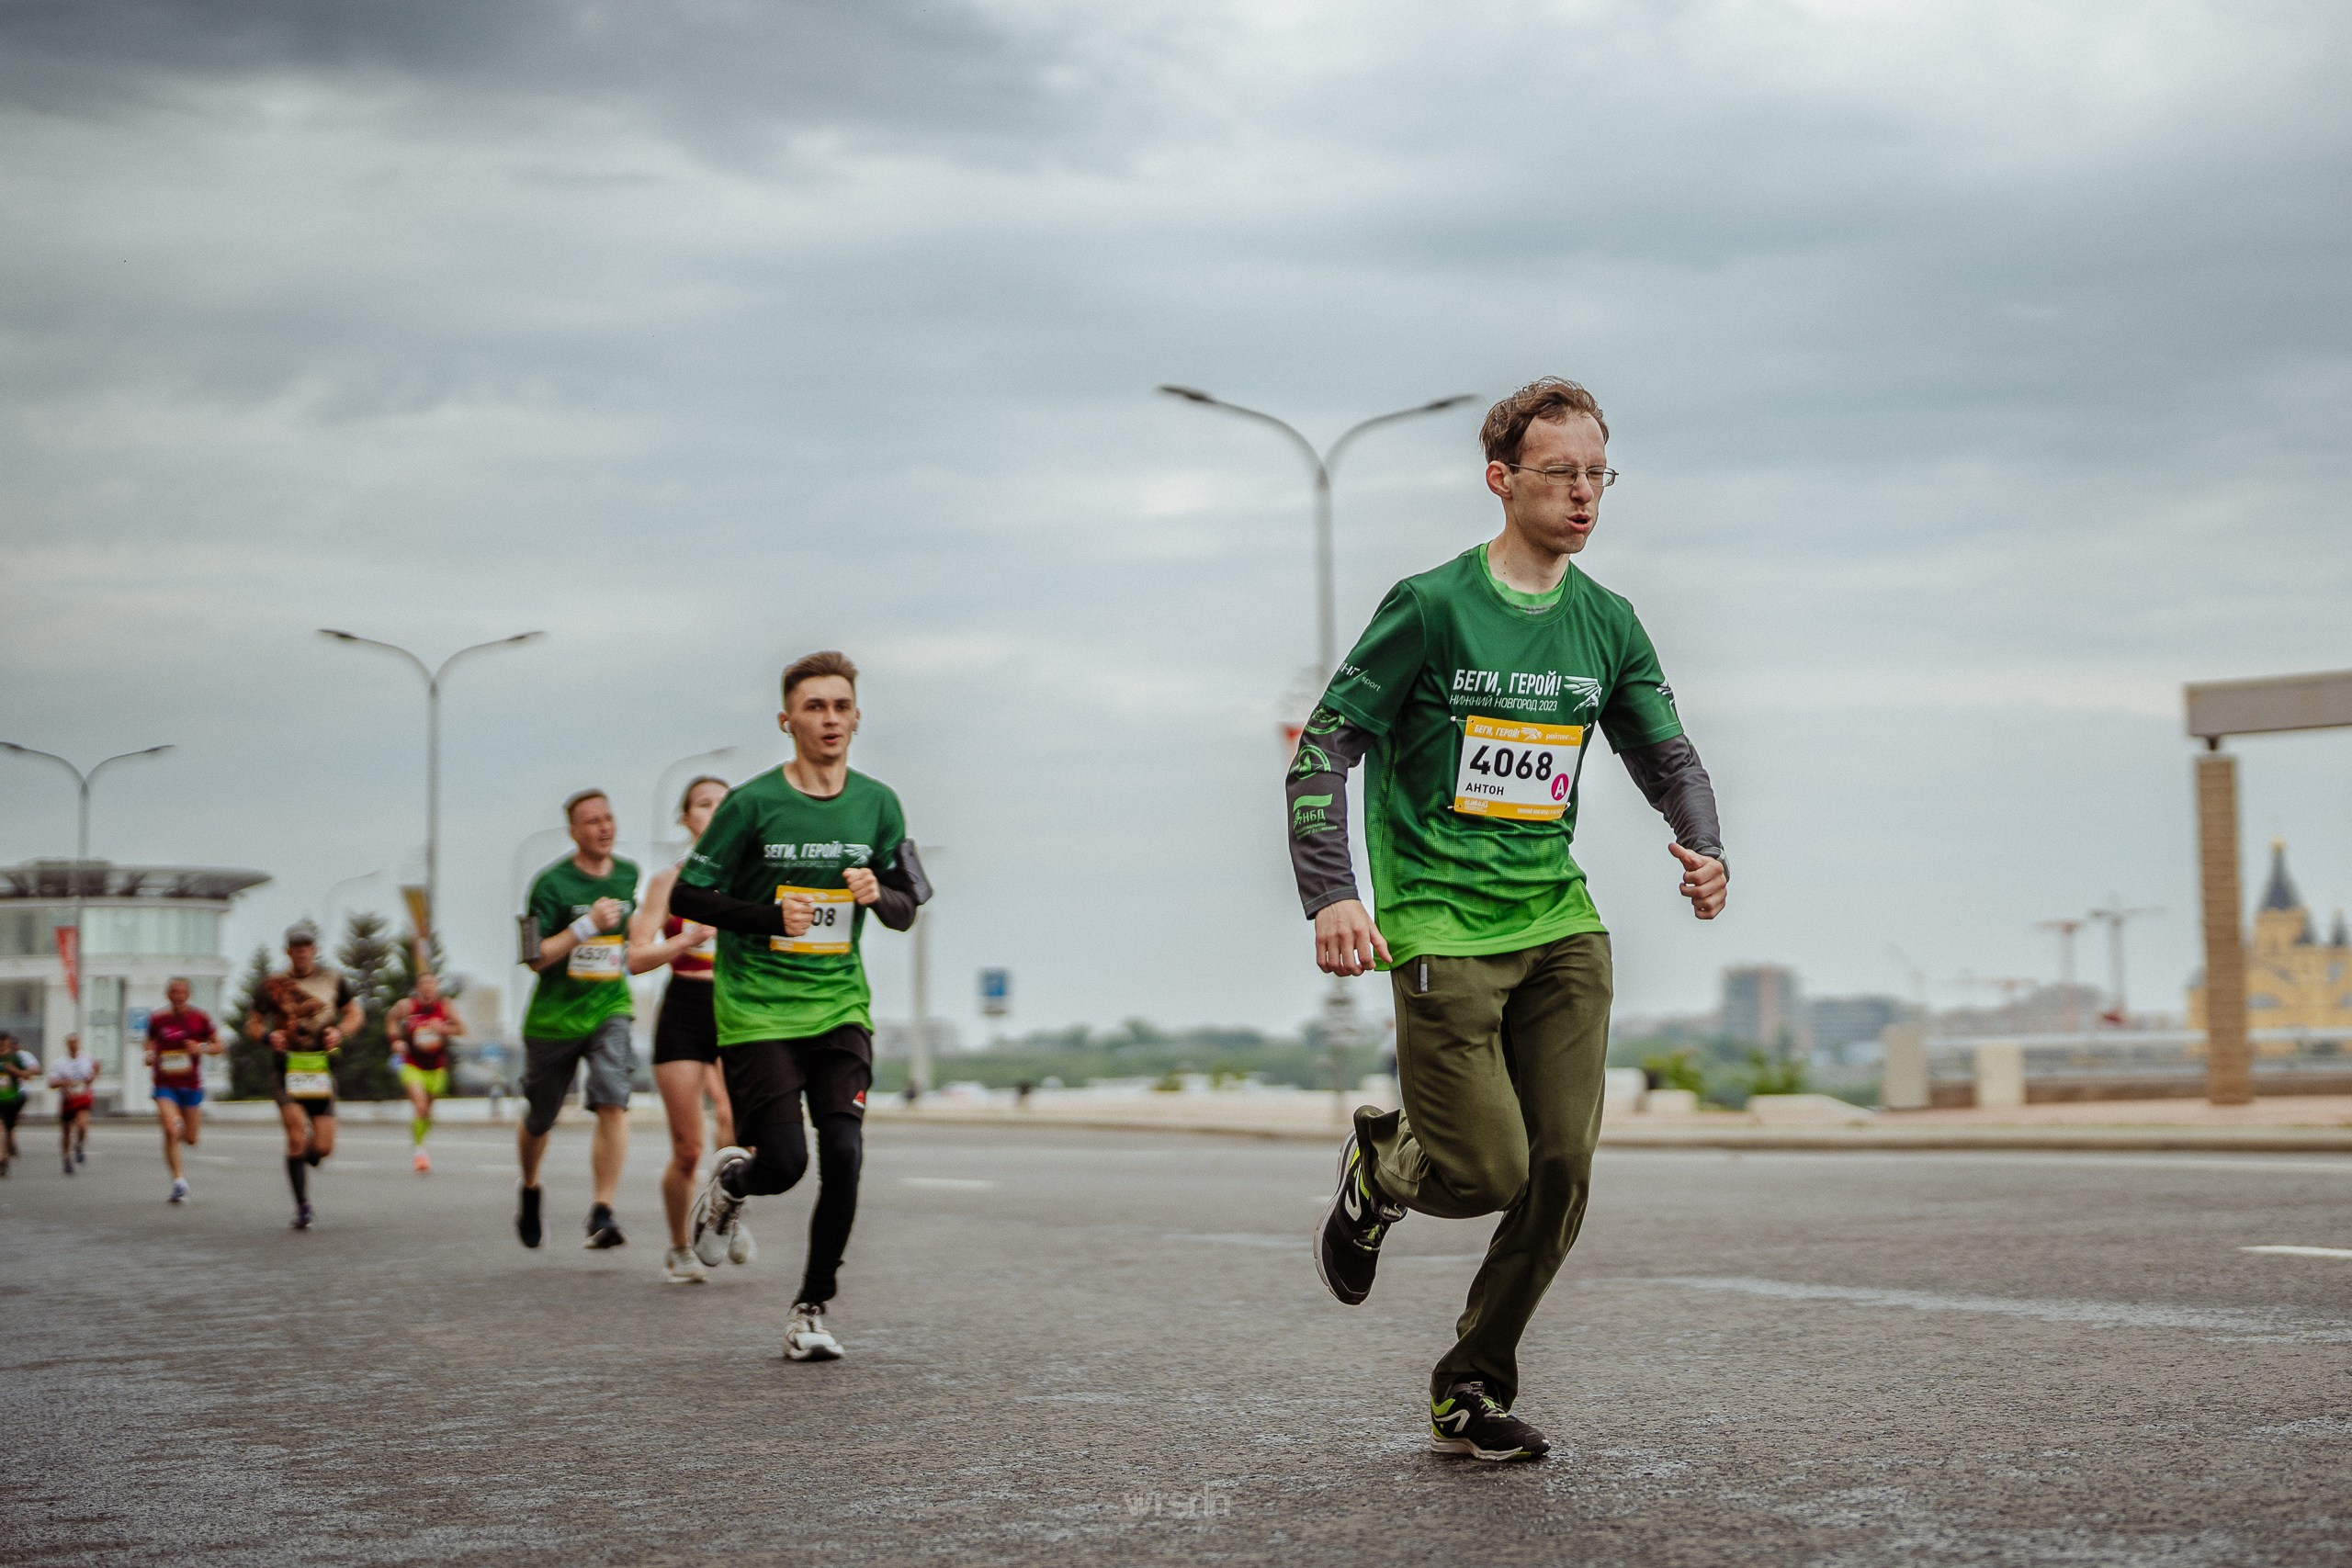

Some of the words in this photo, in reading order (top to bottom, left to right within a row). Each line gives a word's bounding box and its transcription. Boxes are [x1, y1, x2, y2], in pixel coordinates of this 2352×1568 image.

[1453, 669, 1502, 696] БЕГИ,
[1509, 670, 1562, 696] ГЕРОЙ!
[1449, 694, 1493, 707] НИЖНИЙ
[1494, 696, 1538, 712] НОВГОРОД
[1538, 699, 1558, 712] 2023
[1469, 744, 1554, 781] 4068
[1464, 782, 1505, 796] АНТОН
[1302, 808, 1326, 823] НБД
[811, 907, 836, 927] 08
